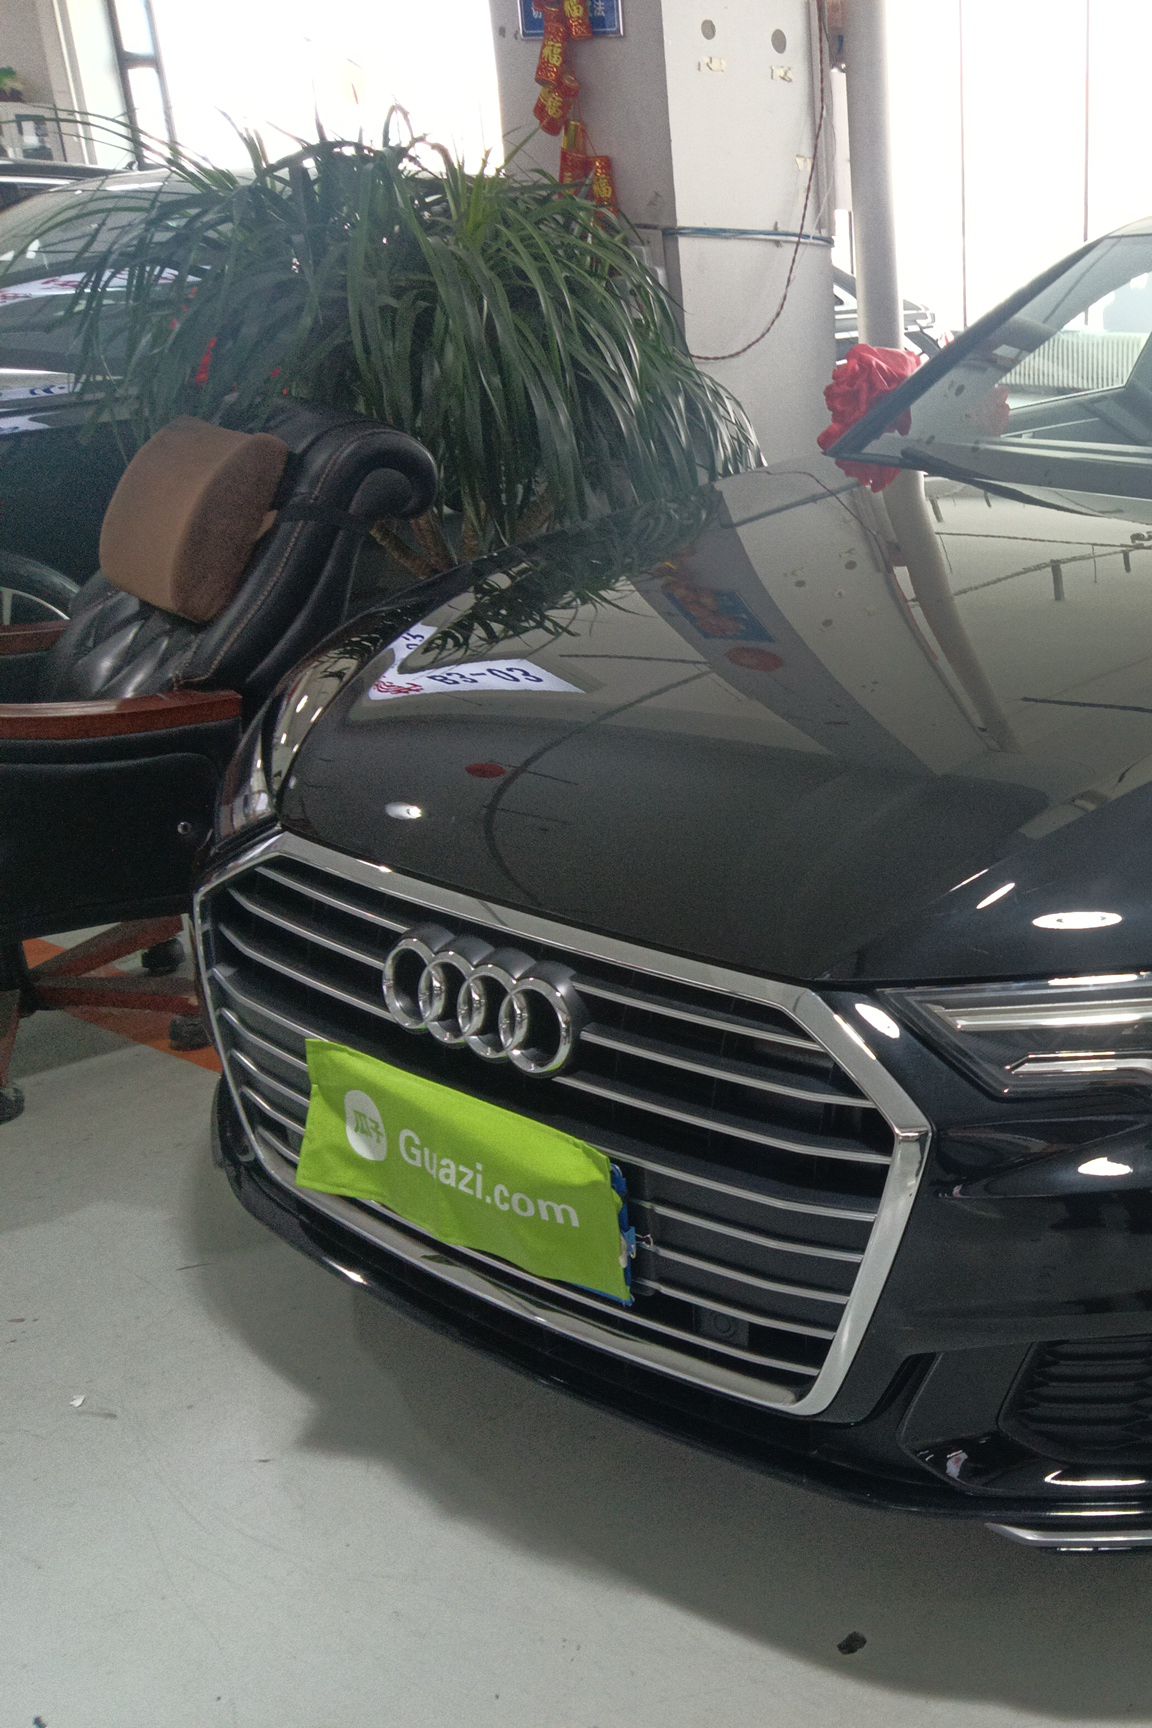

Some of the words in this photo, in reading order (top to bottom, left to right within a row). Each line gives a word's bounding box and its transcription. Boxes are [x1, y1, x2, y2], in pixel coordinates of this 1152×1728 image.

[542, 38, 563, 66] 福
[352, 1110, 384, 1143] 瓜子
[400, 1129, 580, 1228] Guazi.com
